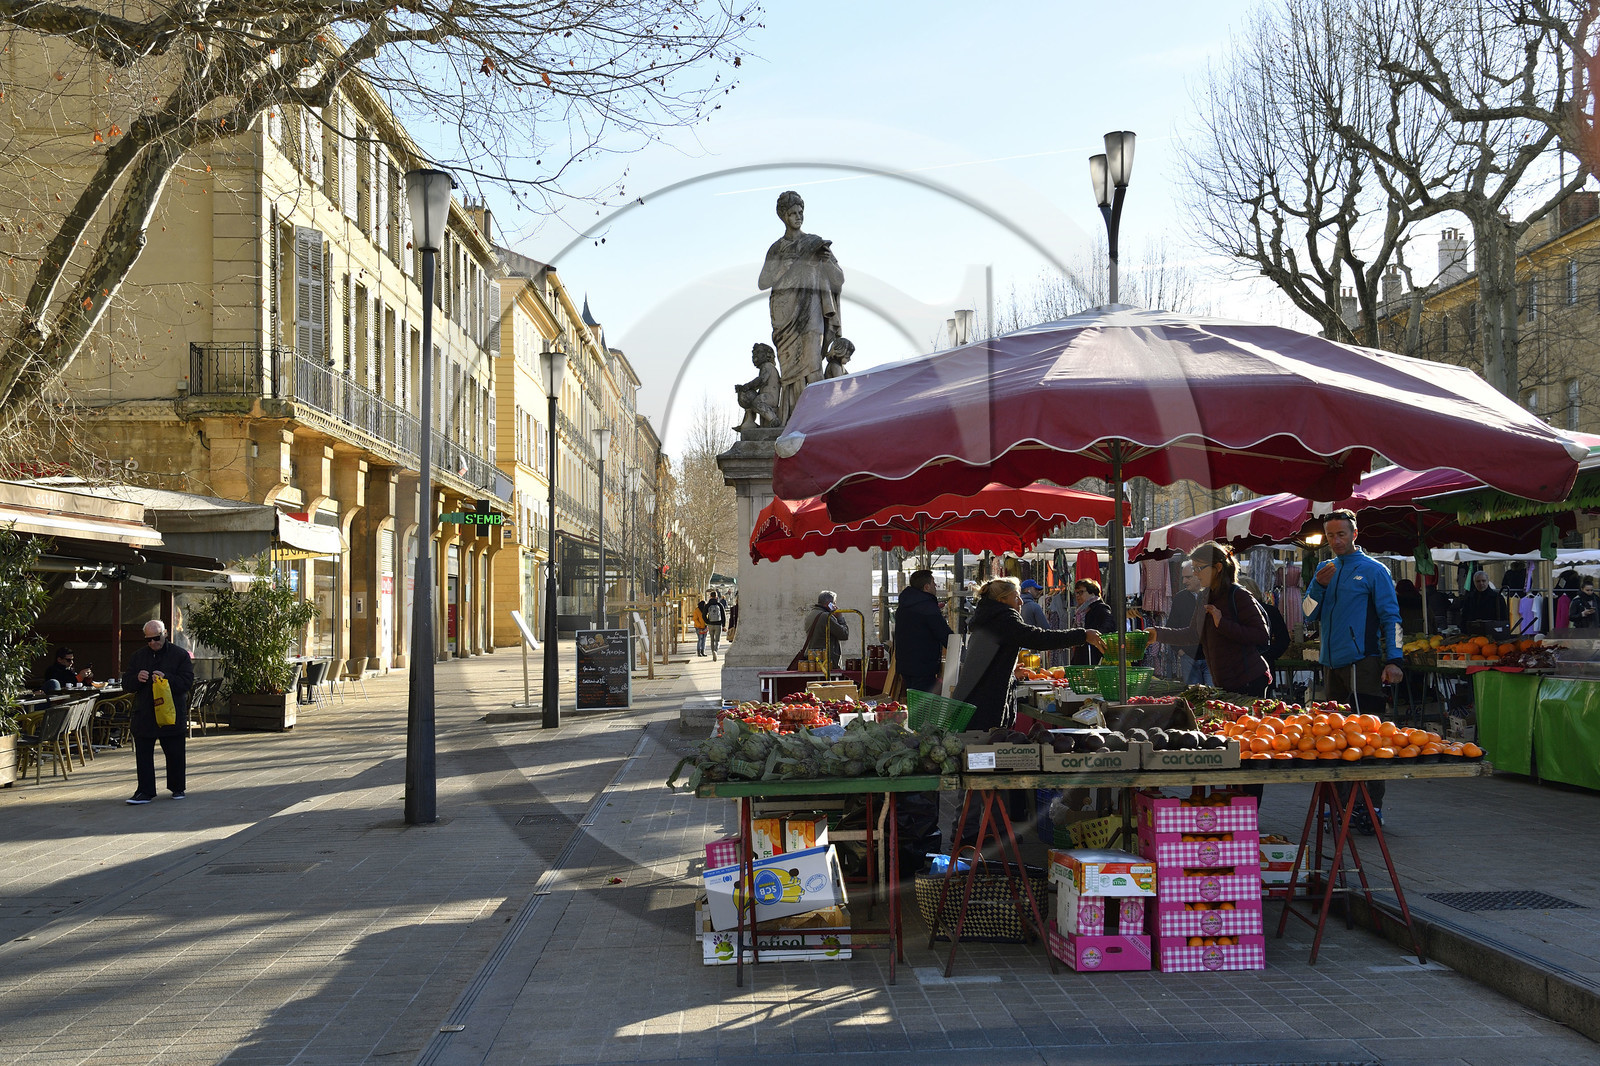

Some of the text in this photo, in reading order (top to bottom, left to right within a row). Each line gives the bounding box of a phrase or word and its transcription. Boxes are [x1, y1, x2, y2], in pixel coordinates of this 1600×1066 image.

[465, 513, 502, 525] S'EMB
[997, 746, 1036, 755] cartama
[1061, 755, 1122, 769] cartama
[1162, 751, 1223, 765] cartama
[759, 885, 777, 895] SCB
